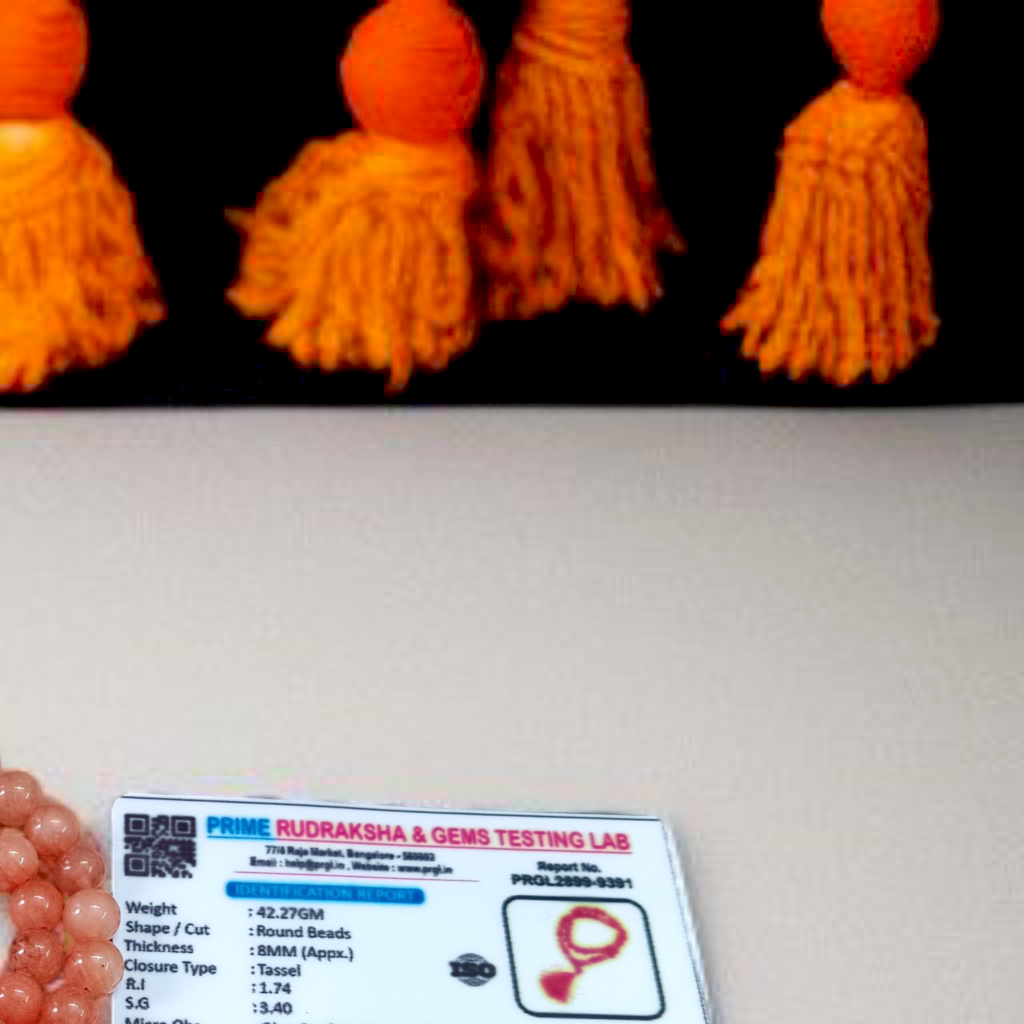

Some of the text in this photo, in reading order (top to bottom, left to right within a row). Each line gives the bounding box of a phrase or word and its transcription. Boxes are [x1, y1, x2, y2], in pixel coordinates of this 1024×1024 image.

[207, 816, 630, 850] PRIME RUDRAKSHA & GEMS TESTING LAB
[250, 856, 276, 867] Email
[352, 861, 389, 871] Website
[537, 861, 601, 873] Report No.
[235, 884, 414, 901] IDENTIFICATION REPORT
[126, 901, 177, 917] Weight
[256, 907, 324, 921] 42.27GM
[126, 922, 170, 936] Shape
[174, 922, 180, 935] /
[185, 924, 210, 936] Cut
[307, 927, 351, 940] Beads
[125, 940, 194, 954] Thickness
[302, 946, 354, 962] (Appx.)
[124, 961, 178, 974] Closure
[182, 962, 216, 976] Type
[450, 962, 496, 978] ISO
[126, 979, 145, 991] R.I
[126, 997, 149, 1010] S.G
